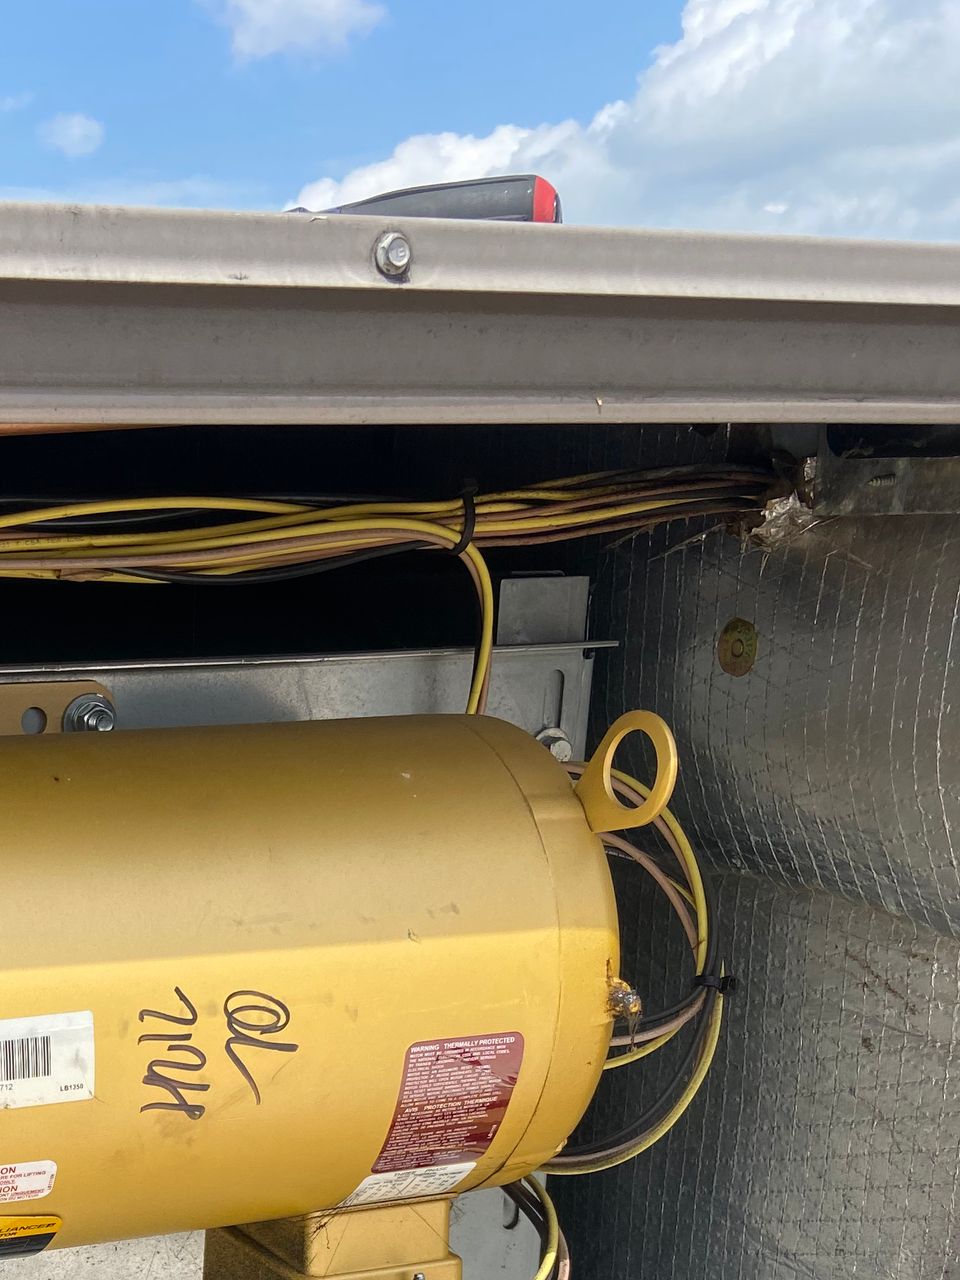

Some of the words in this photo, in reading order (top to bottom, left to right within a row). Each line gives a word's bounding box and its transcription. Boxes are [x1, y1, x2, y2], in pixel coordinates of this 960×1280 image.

[410, 1043, 440, 1053] WARNING
[443, 1040, 479, 1050] THERMALLY
[479, 1037, 515, 1046] PROTECTED
[423, 1101, 462, 1111] PROTECTION
[464, 1096, 498, 1106] THERMIQUE
[23, 1170, 47, 1179] LIFTING
